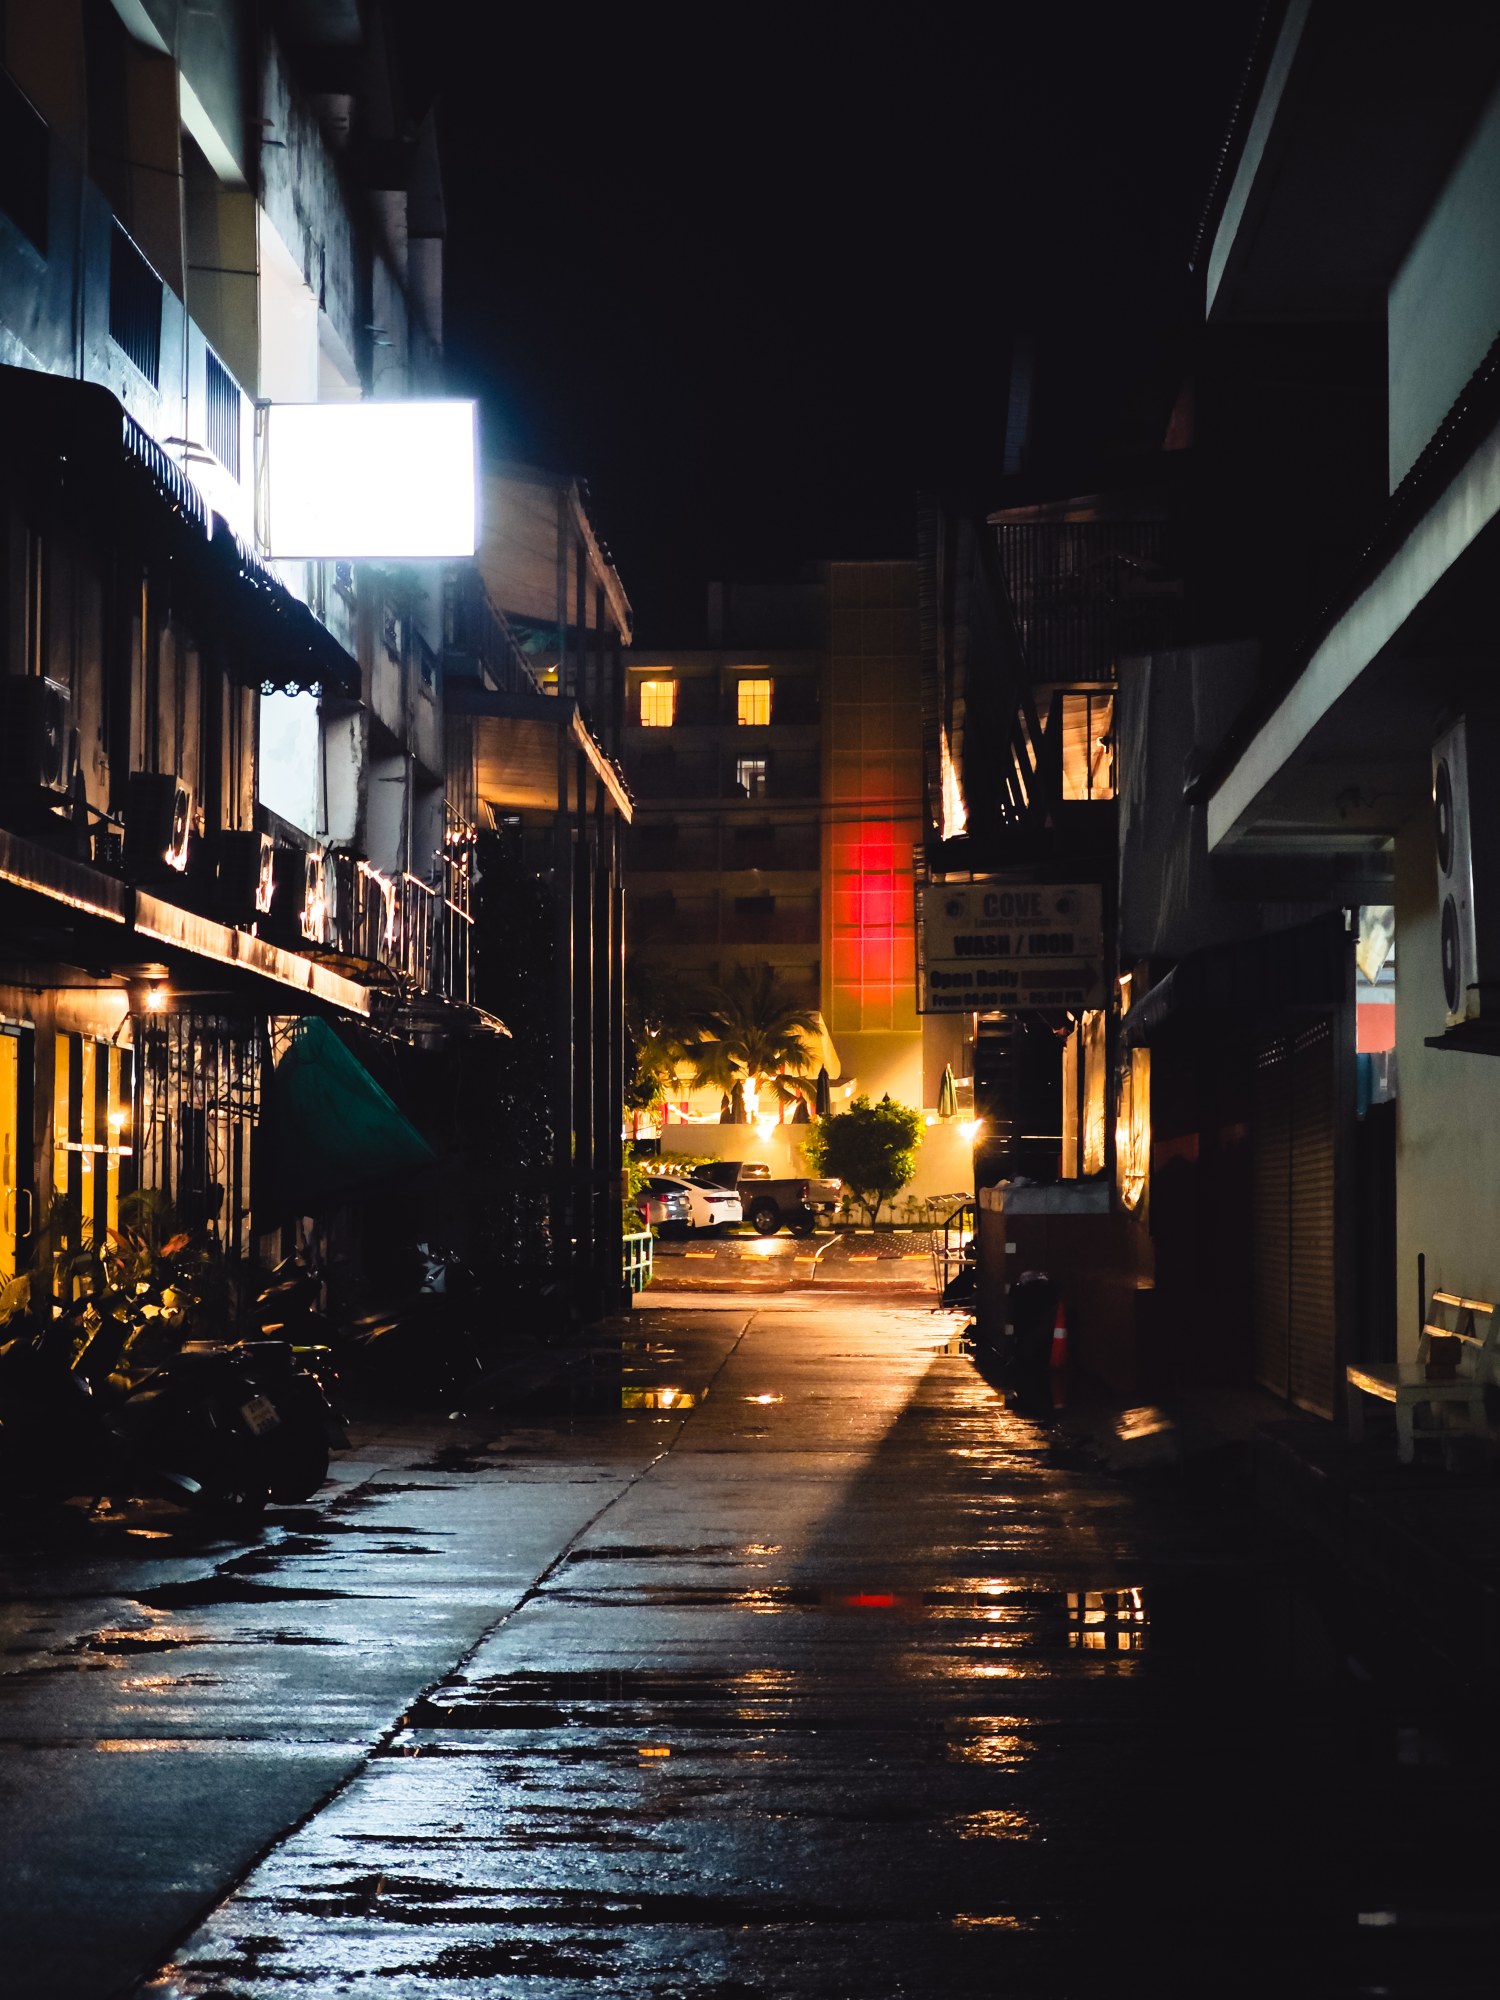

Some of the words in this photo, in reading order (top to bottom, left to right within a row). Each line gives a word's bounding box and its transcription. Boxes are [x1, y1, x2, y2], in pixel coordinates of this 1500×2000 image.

[984, 892, 1042, 917] COVE
[953, 935, 1010, 956] WASH
[1015, 934, 1024, 954] /
[1028, 933, 1074, 954] IRON
[930, 970, 973, 990] Open
[976, 969, 1019, 988] Daily
[932, 994, 962, 1007] From
